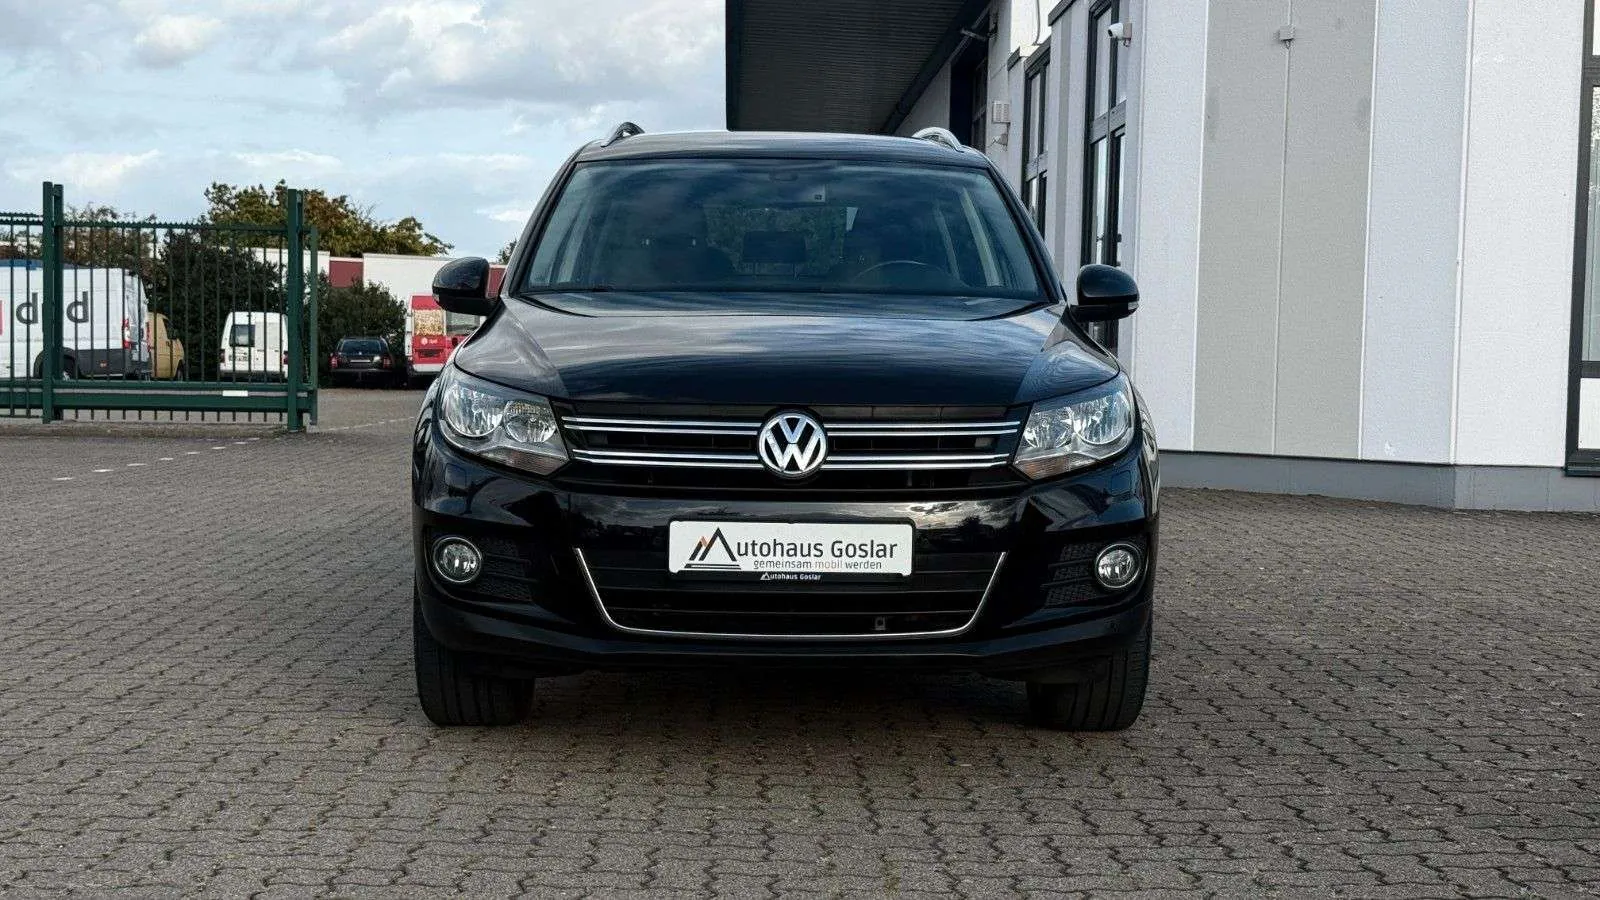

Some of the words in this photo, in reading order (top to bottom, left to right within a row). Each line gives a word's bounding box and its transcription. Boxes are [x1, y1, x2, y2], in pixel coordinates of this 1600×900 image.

[16, 291, 89, 324] dd
[759, 413, 827, 477] VW
[687, 527, 824, 560] Autohaus
[831, 539, 898, 559] Goslar
[753, 560, 812, 570] gemeinsam
[815, 560, 842, 570] mobil
[845, 561, 882, 570] werden
[760, 572, 798, 581] Autohaus
[800, 573, 821, 581] Goslar
